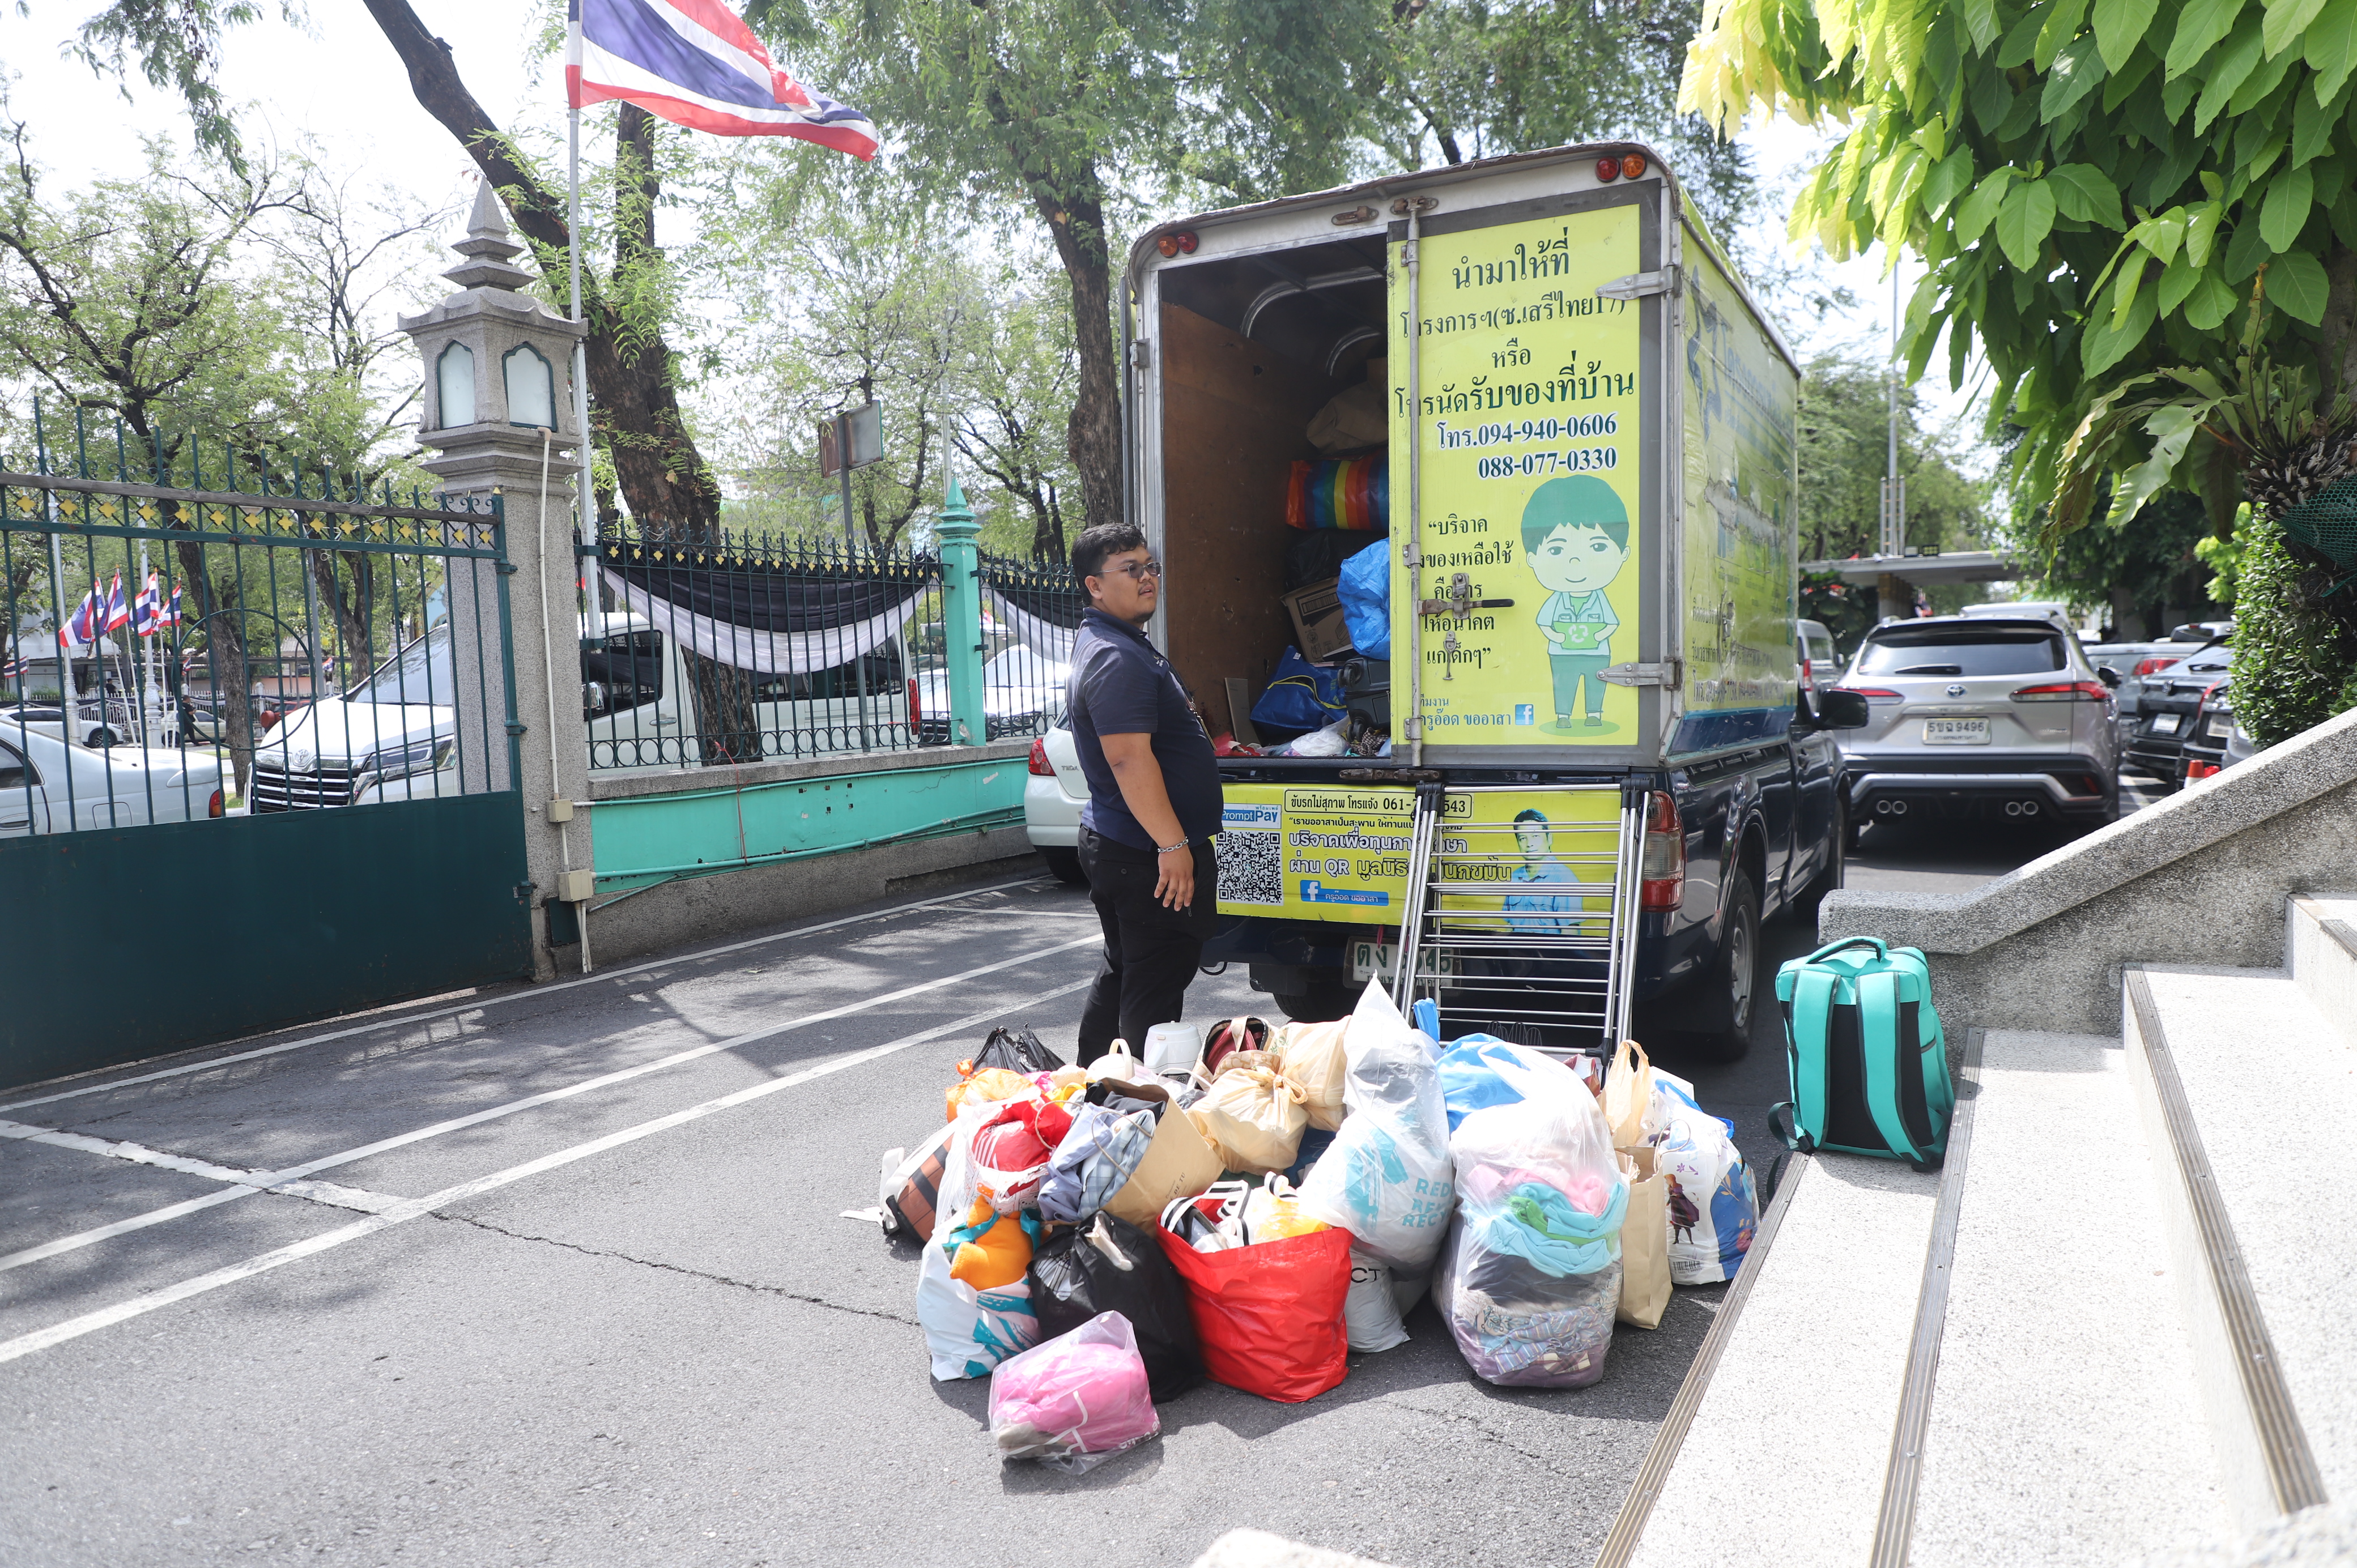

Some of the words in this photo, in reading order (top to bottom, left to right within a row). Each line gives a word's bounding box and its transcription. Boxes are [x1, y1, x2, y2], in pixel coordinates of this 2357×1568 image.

[1452, 227, 1569, 289] นำมาให้ที่
[1492, 337, 1531, 368] หรือ
[1479, 448, 1616, 479] 088-077-0330
[1435, 577, 1483, 600] คือาร
[1463, 714, 1511, 726] ขออาสา
[1956, 721, 1985, 732] 9496
[1291, 794, 1345, 811] ขับรถไม่สุภาพ
[1347, 795, 1378, 809] โทรแจ้ง
[1290, 850, 1321, 874] ผ่าน
[1325, 859, 1350, 877] QR
[1325, 890, 1349, 902] ครูอ๊อด
